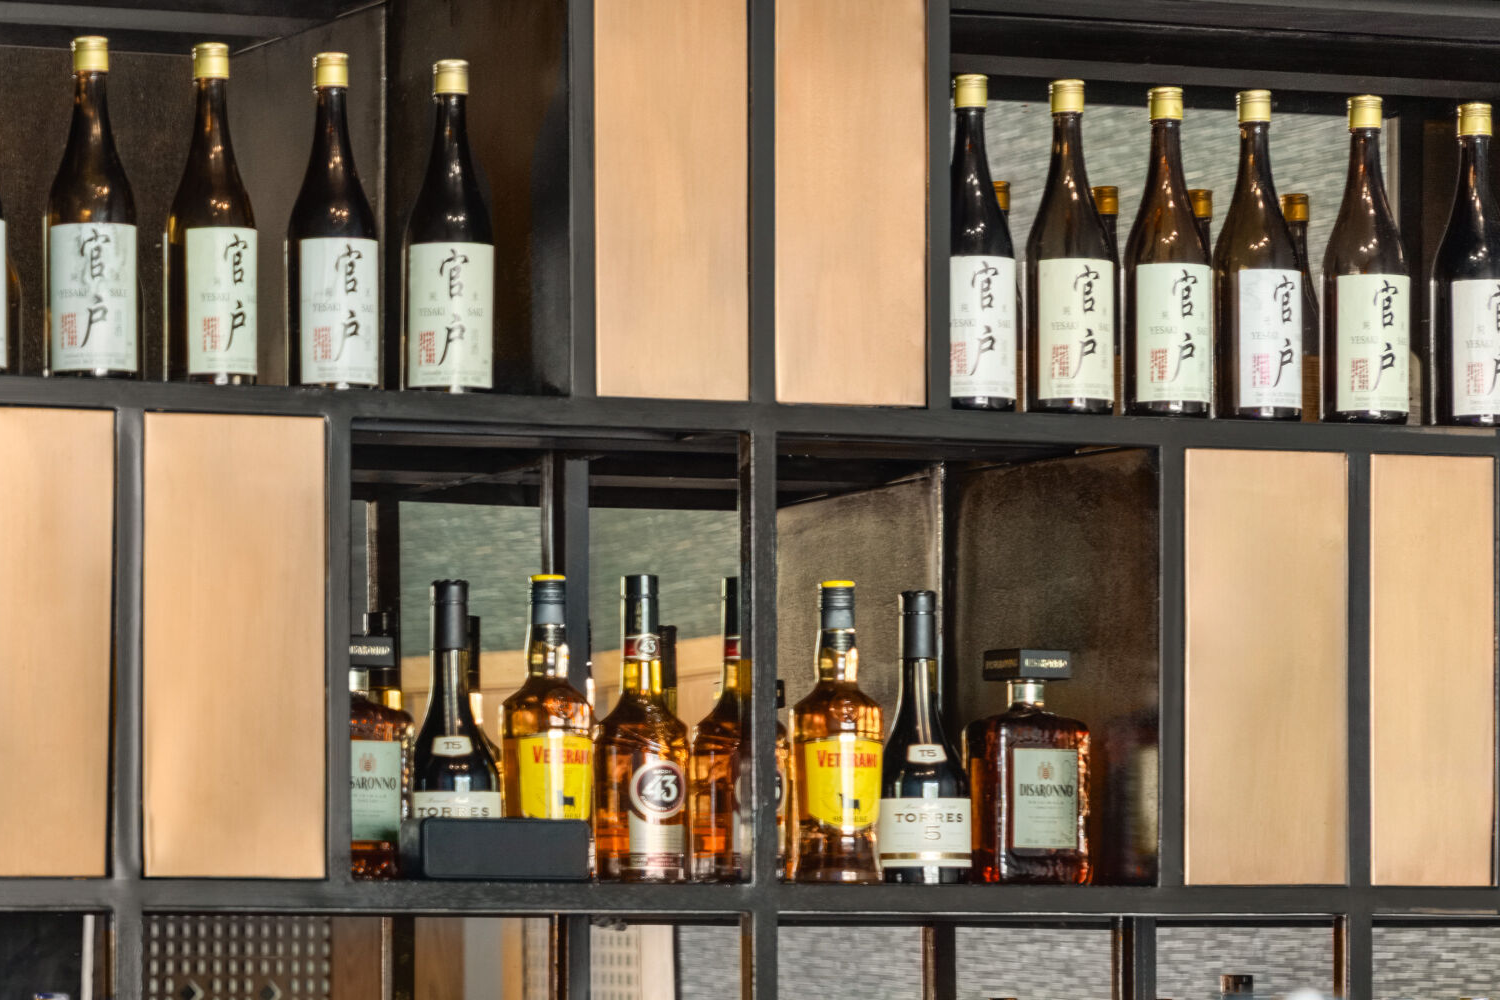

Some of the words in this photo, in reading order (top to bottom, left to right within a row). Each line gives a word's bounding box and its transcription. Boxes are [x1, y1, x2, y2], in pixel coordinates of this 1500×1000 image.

[640, 640, 656, 652] 43
[532, 745, 591, 764] VEERAN
[817, 750, 877, 768] VETRAN
[642, 775, 678, 801] 43
[1020, 783, 1074, 797] DISARONNO
[418, 807, 490, 816] TORRES
[894, 813, 963, 823] TORRES
[924, 826, 942, 840] 5
